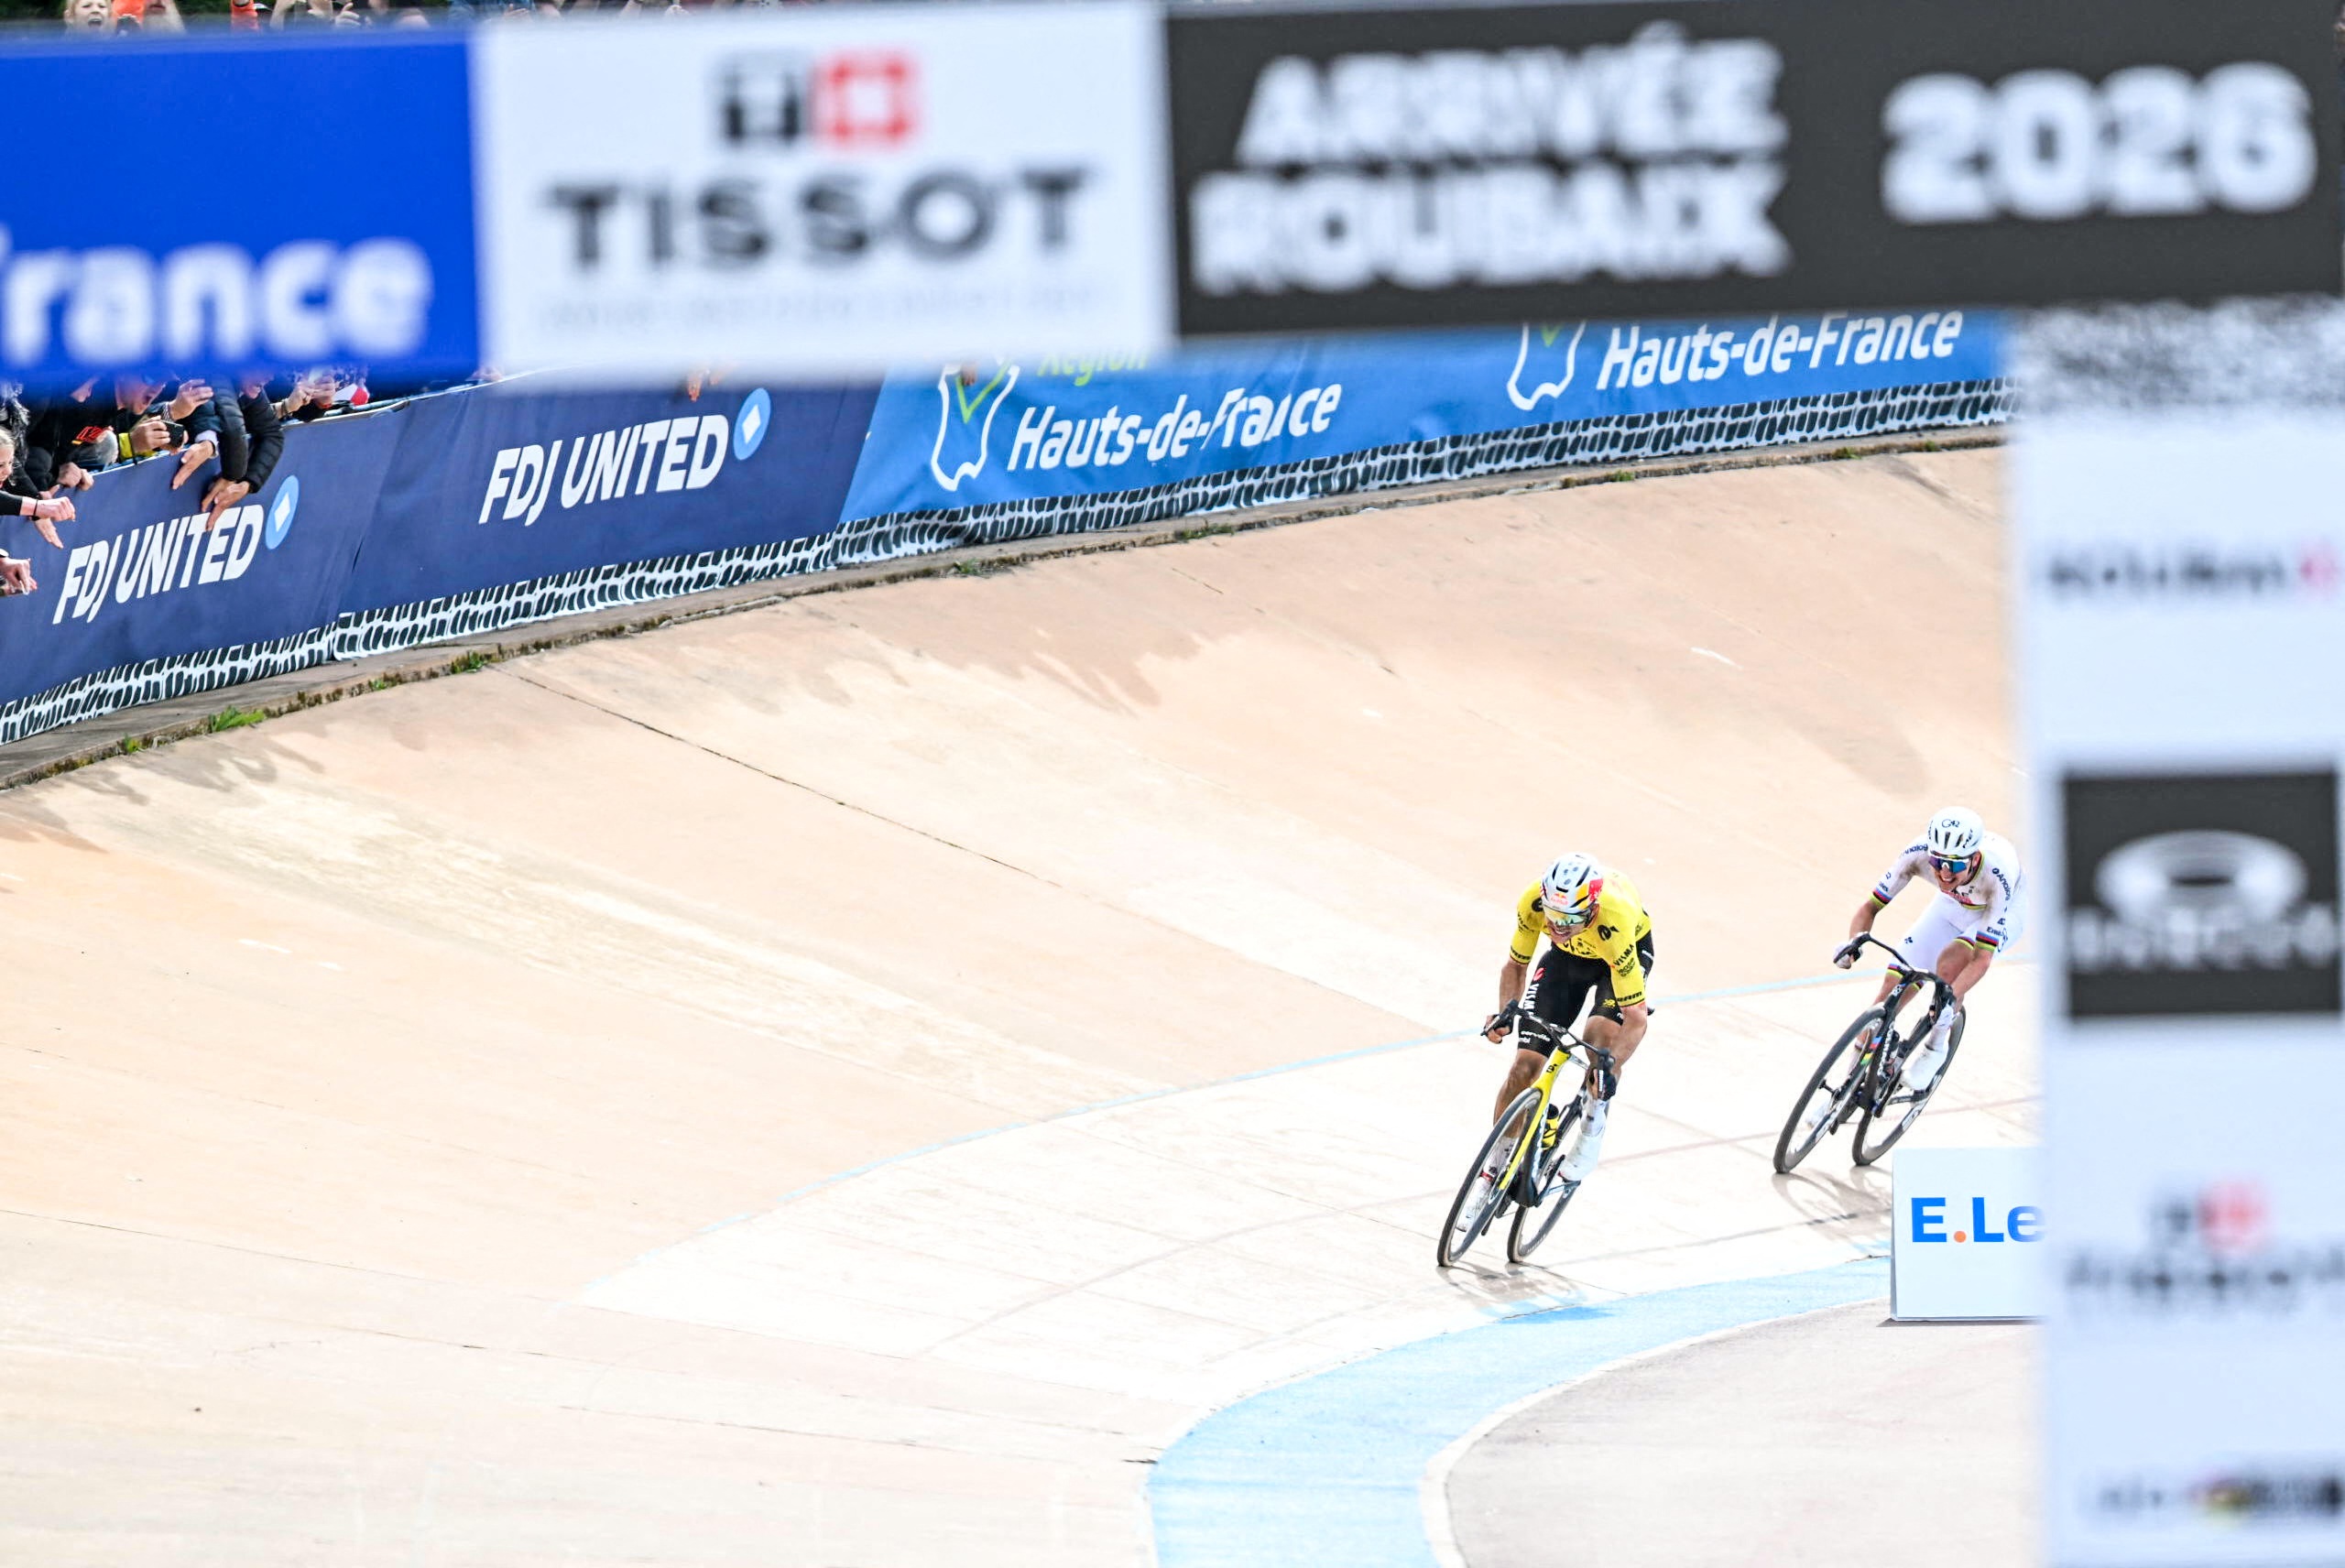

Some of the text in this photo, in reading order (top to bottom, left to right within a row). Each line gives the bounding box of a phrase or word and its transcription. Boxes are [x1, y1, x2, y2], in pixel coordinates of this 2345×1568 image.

[1237, 22, 1788, 170] ARRIVÉE
[1880, 60, 2319, 225] 2026
[546, 167, 1092, 273] TISSOT
[1189, 165, 1793, 297] ROUBAIX
[0, 229, 434, 366] rance
[1596, 310, 1964, 391] Hauts-de-France
[478, 414, 729, 527] FDJ UNITED
[52, 504, 264, 625] FDJ UNITED
[1613, 943, 1634, 966] VISMA
